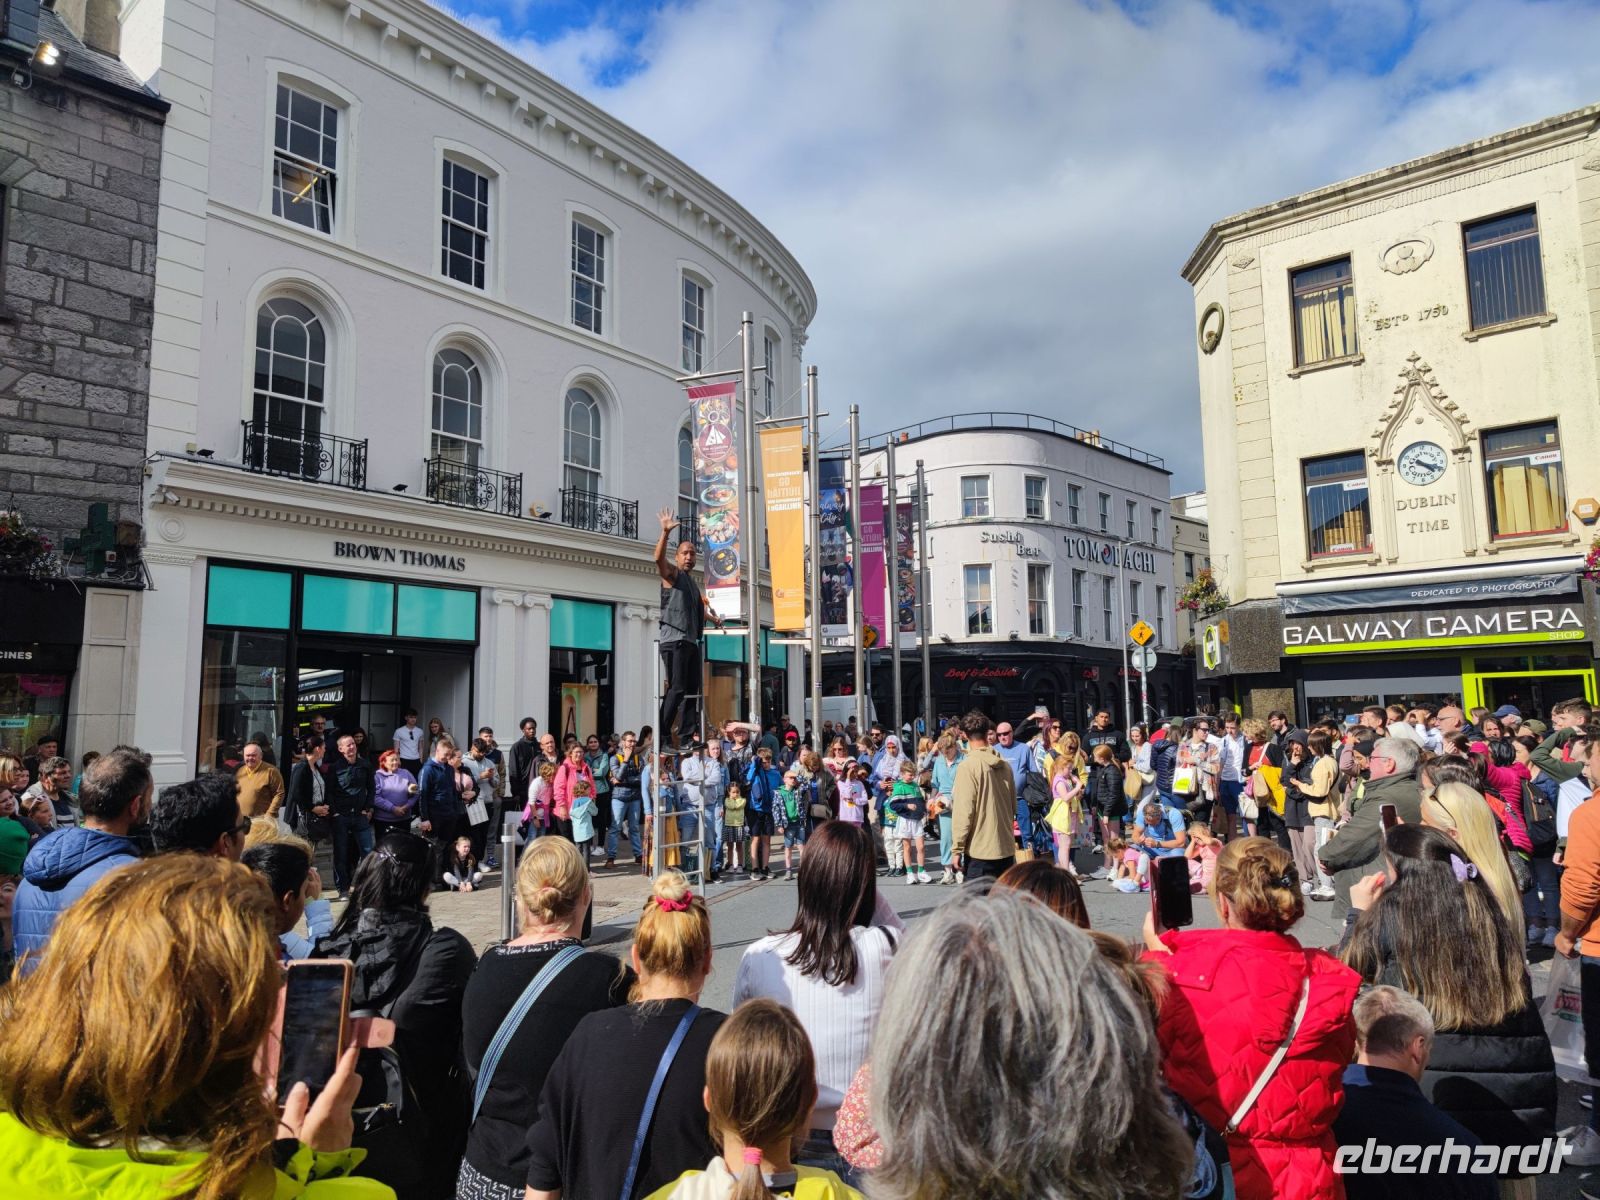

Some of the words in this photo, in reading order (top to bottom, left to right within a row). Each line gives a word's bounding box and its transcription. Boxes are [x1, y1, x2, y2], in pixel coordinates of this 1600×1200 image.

[1396, 493, 1456, 511] DUBLIN
[1407, 519, 1450, 533] TIME
[981, 531, 1021, 543] Sushi
[334, 541, 396, 562] BROWN
[400, 549, 466, 572] THOMAS
[1016, 543, 1041, 557] Bar
[1411, 587, 1463, 597] DEDICATED
[1482, 579, 1557, 593] PHOTOGRAPHY
[1283, 618, 1412, 645] GALWAY
[1426, 607, 1583, 637] CAMERA
[1549, 631, 1580, 640] SHOP
